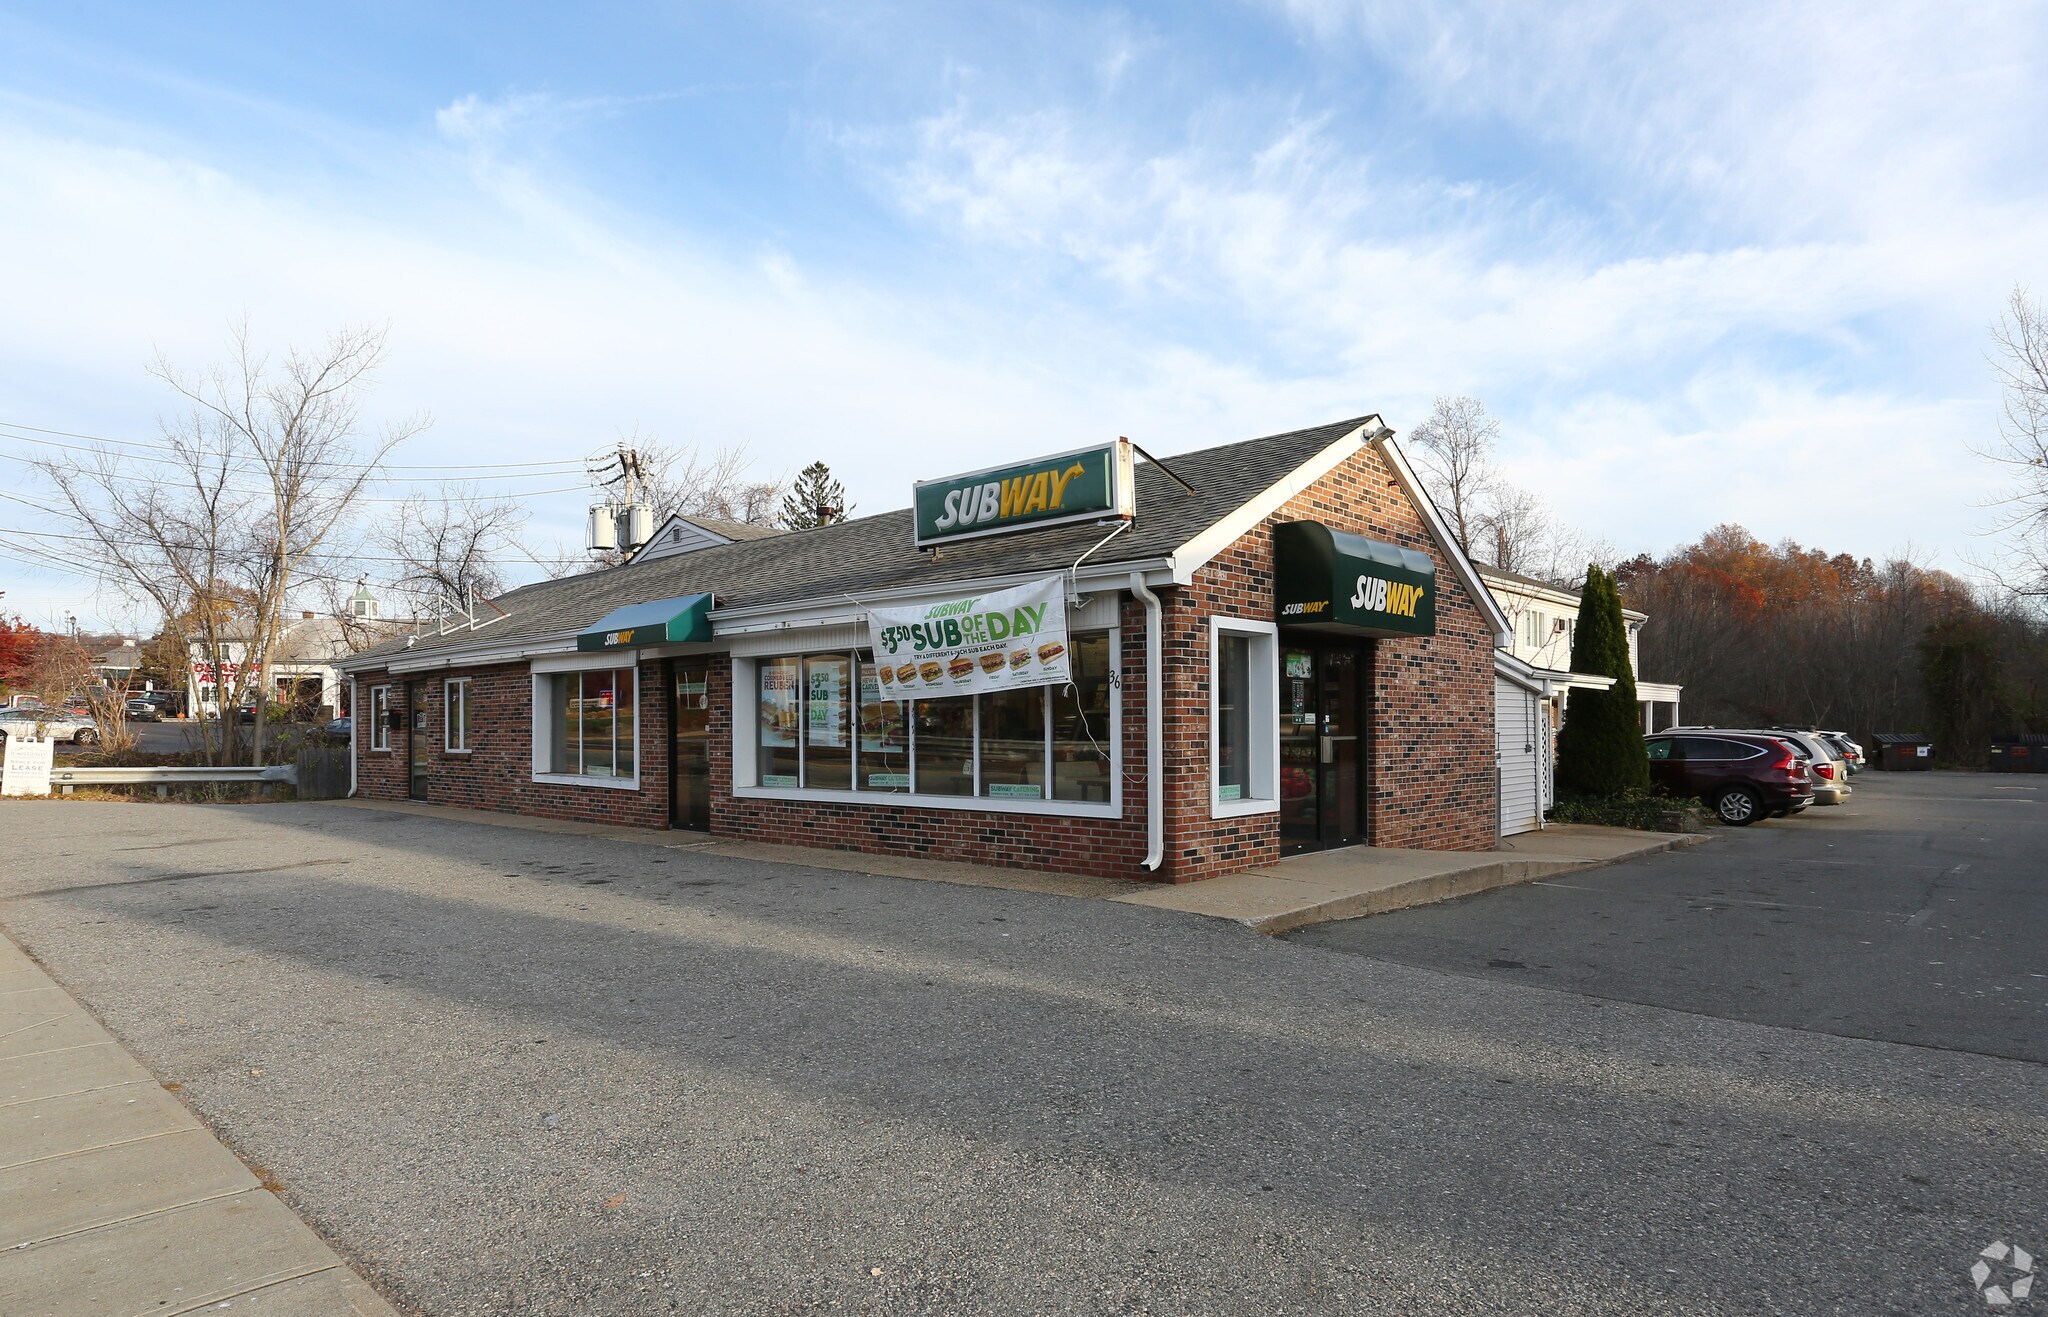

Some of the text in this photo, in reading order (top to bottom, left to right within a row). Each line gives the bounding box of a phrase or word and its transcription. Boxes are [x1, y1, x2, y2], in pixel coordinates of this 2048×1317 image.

[935, 460, 1085, 532] SUBWAY
[1350, 574, 1424, 618] SUBWAY
[924, 598, 981, 620] SUBWAY
[1281, 600, 1329, 616] SUBWAY
[961, 614, 983, 632] OF
[986, 602, 1048, 641] DAY
[604, 629, 635, 646] SUBWAY
[911, 618, 962, 651] SUB
[963, 631, 988, 645] THE
[926, 651, 950, 659] DIFFERENT
[764, 681, 795, 690] REUBEN
[1109, 669, 1121, 689] 36
[811, 690, 829, 701] SUB
[811, 709, 829, 721] DAY
